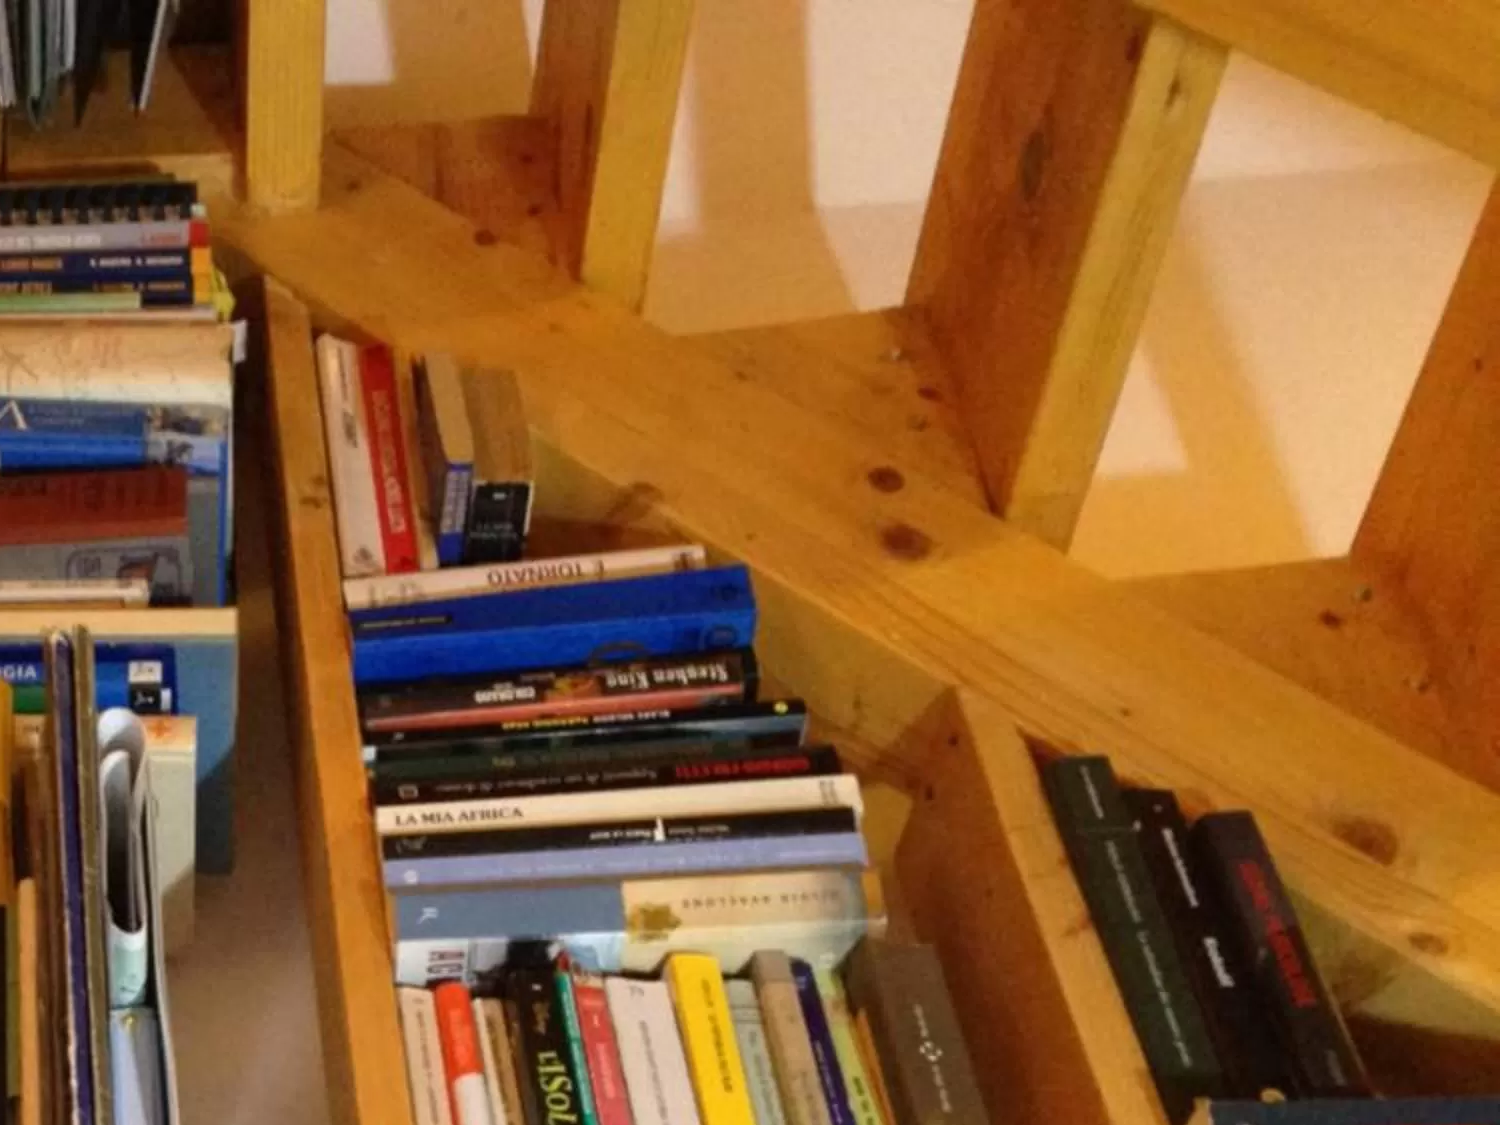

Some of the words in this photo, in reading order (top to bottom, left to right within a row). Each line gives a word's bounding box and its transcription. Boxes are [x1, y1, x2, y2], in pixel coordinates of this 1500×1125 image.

[486, 561, 584, 587] TORNATO
[605, 671, 650, 691] King
[652, 662, 729, 686] Stephen
[394, 813, 419, 828] LA
[422, 811, 455, 826] MIA
[458, 806, 524, 823] AFRICA
